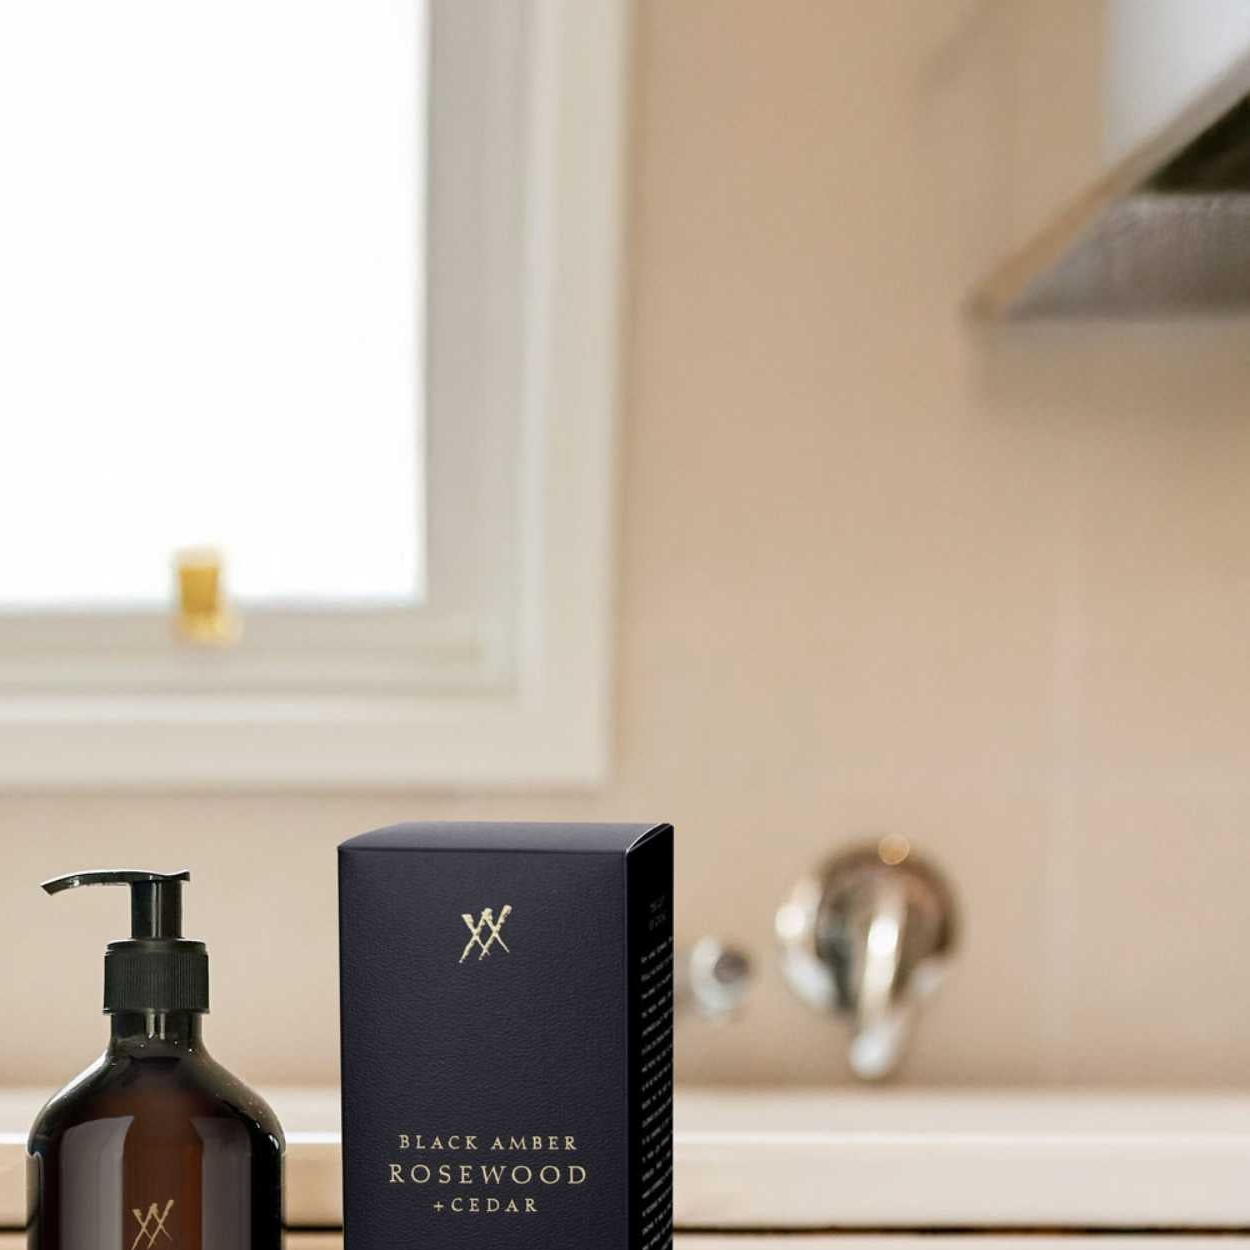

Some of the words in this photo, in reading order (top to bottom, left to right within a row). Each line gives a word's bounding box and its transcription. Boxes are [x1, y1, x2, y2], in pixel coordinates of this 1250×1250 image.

[398, 1134, 479, 1150] BLACK
[490, 1135, 577, 1151] AMBER
[388, 1163, 587, 1185] ROSEWOOD
